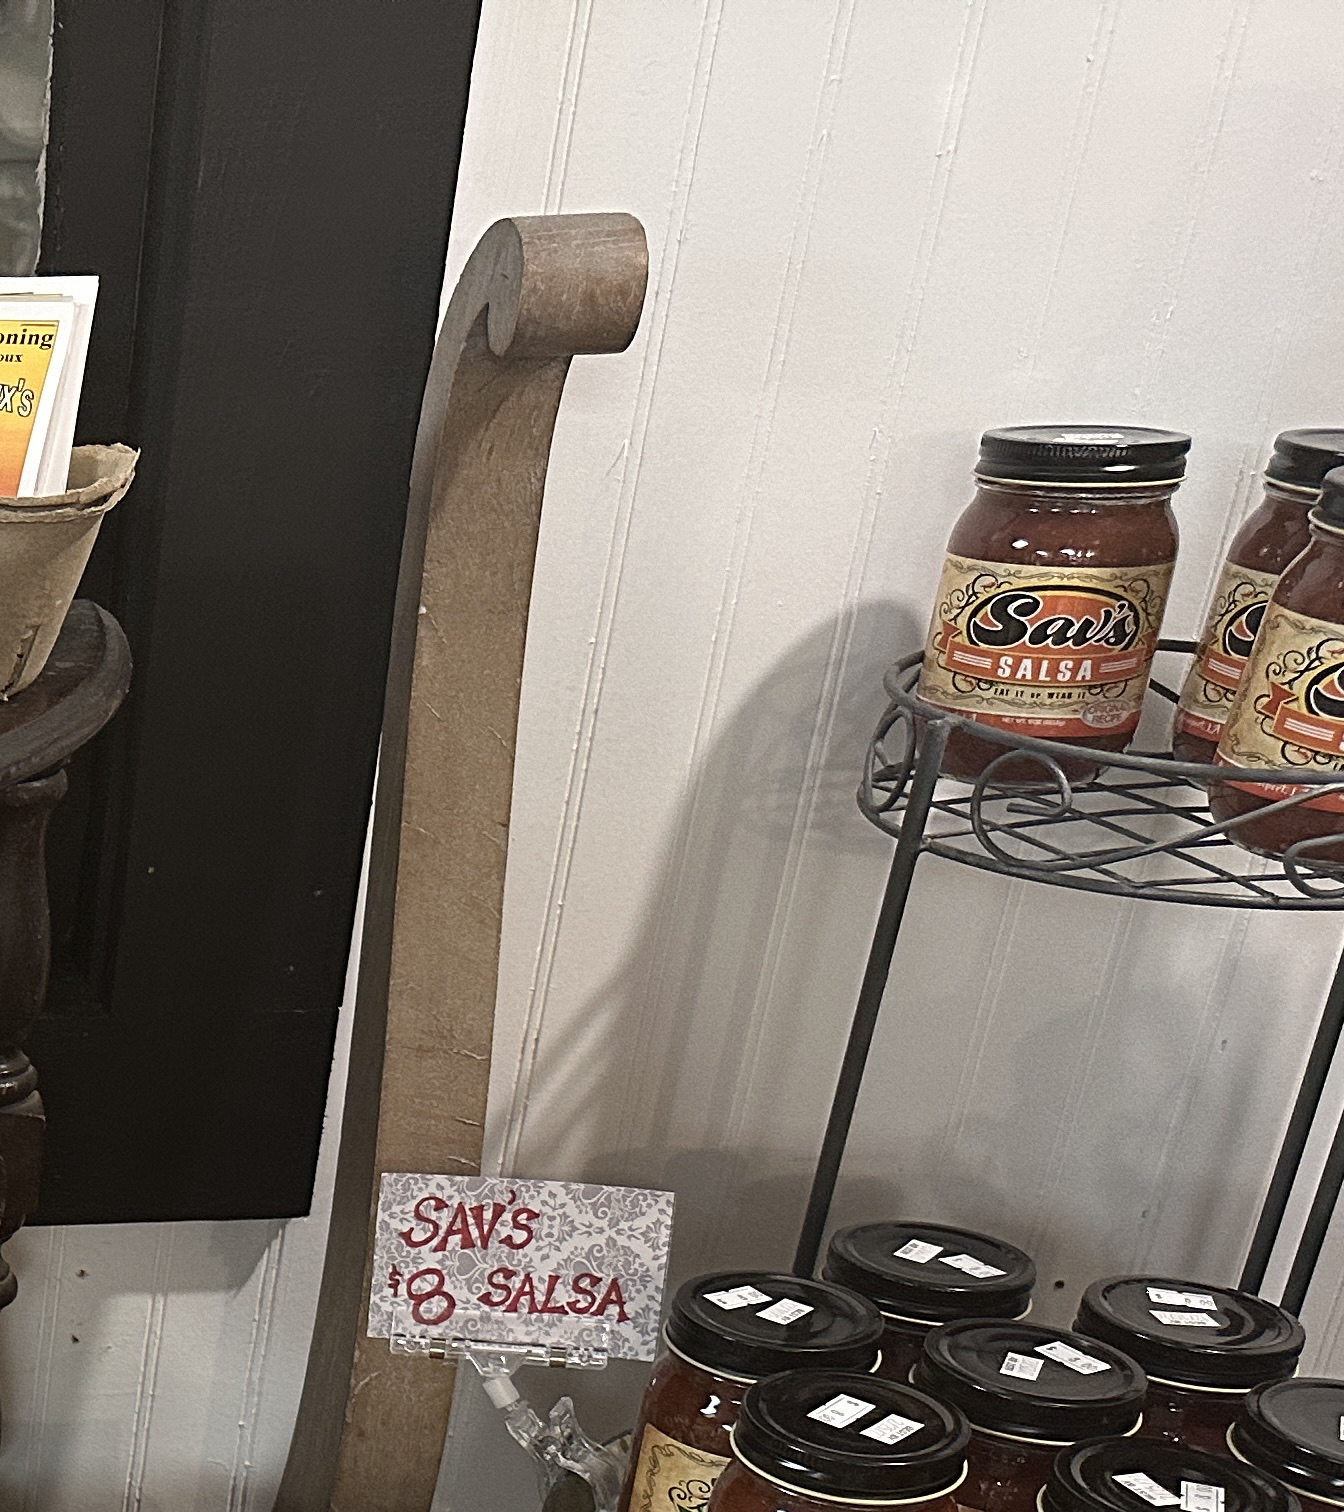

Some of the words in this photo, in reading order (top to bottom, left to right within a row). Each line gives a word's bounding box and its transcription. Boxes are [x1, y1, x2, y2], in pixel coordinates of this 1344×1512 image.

[970, 589, 1141, 651] Sav's
[996, 654, 1094, 683] SALSA
[1047, 690, 1073, 700] WEAR
[399, 1189, 541, 1252] SAV'S
[476, 1267, 631, 1323] SALSA
